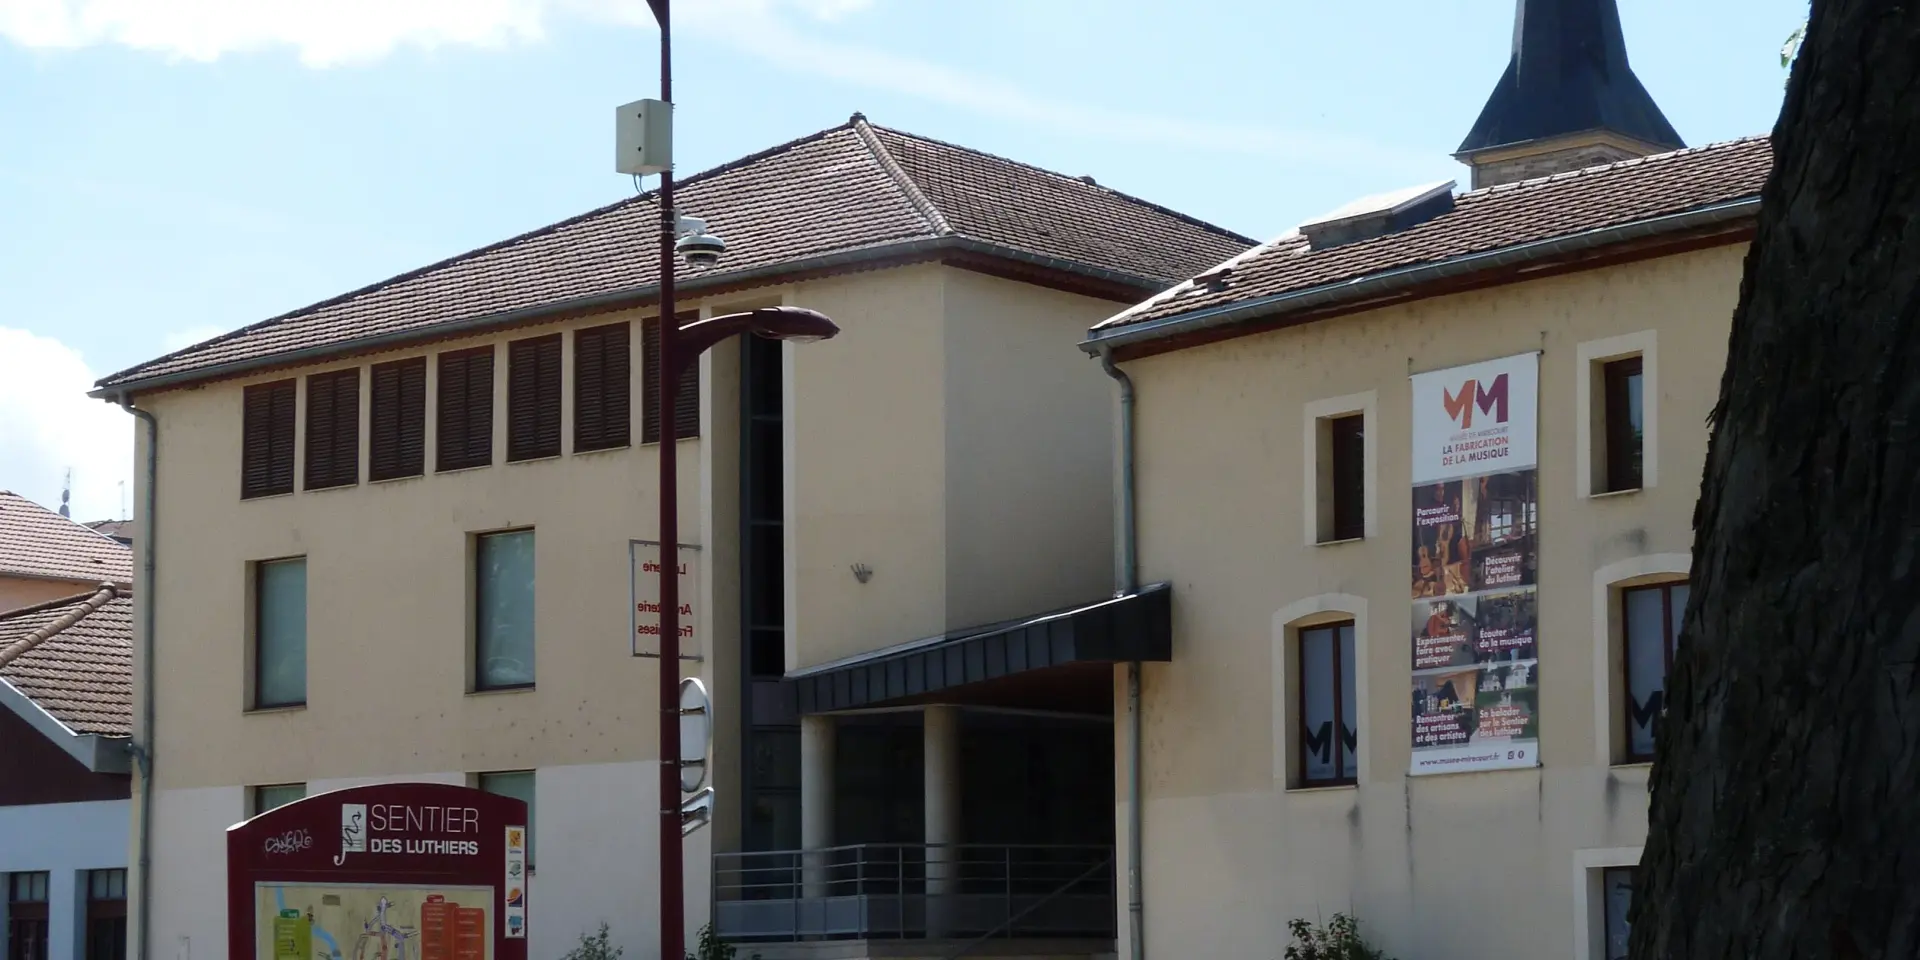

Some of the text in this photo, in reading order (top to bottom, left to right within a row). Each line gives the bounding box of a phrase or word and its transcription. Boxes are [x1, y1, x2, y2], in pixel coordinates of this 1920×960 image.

[1444, 373, 1508, 429] MM
[1443, 436, 1508, 455] LA FABRICATION
[1442, 447, 1509, 466] DE LA MUSIQUE
[1416, 504, 1450, 517] Parcourir
[1416, 513, 1459, 527] l'exposition
[1485, 552, 1521, 565] Découvrir
[1485, 563, 1515, 576] l'atelier
[1485, 573, 1521, 585] du luthier
[1479, 627, 1507, 638] Écouter
[1479, 635, 1533, 648] de la musique
[1416, 644, 1433, 656] faire
[1416, 654, 1450, 667] pratiquer
[1416, 713, 1454, 724] Rencontrer
[1479, 706, 1520, 719] Se balader
[1416, 721, 1459, 733] des artisans
[1479, 715, 1528, 728] sur le Sentier
[1416, 730, 1466, 743] et des artistes
[1480, 725, 1522, 737] des luthiers
[1420, 752, 1500, 766] www.musee-mirecourt.fr
[370, 804, 479, 833] SENTIER
[371, 838, 478, 856] DES LUTHIERS
